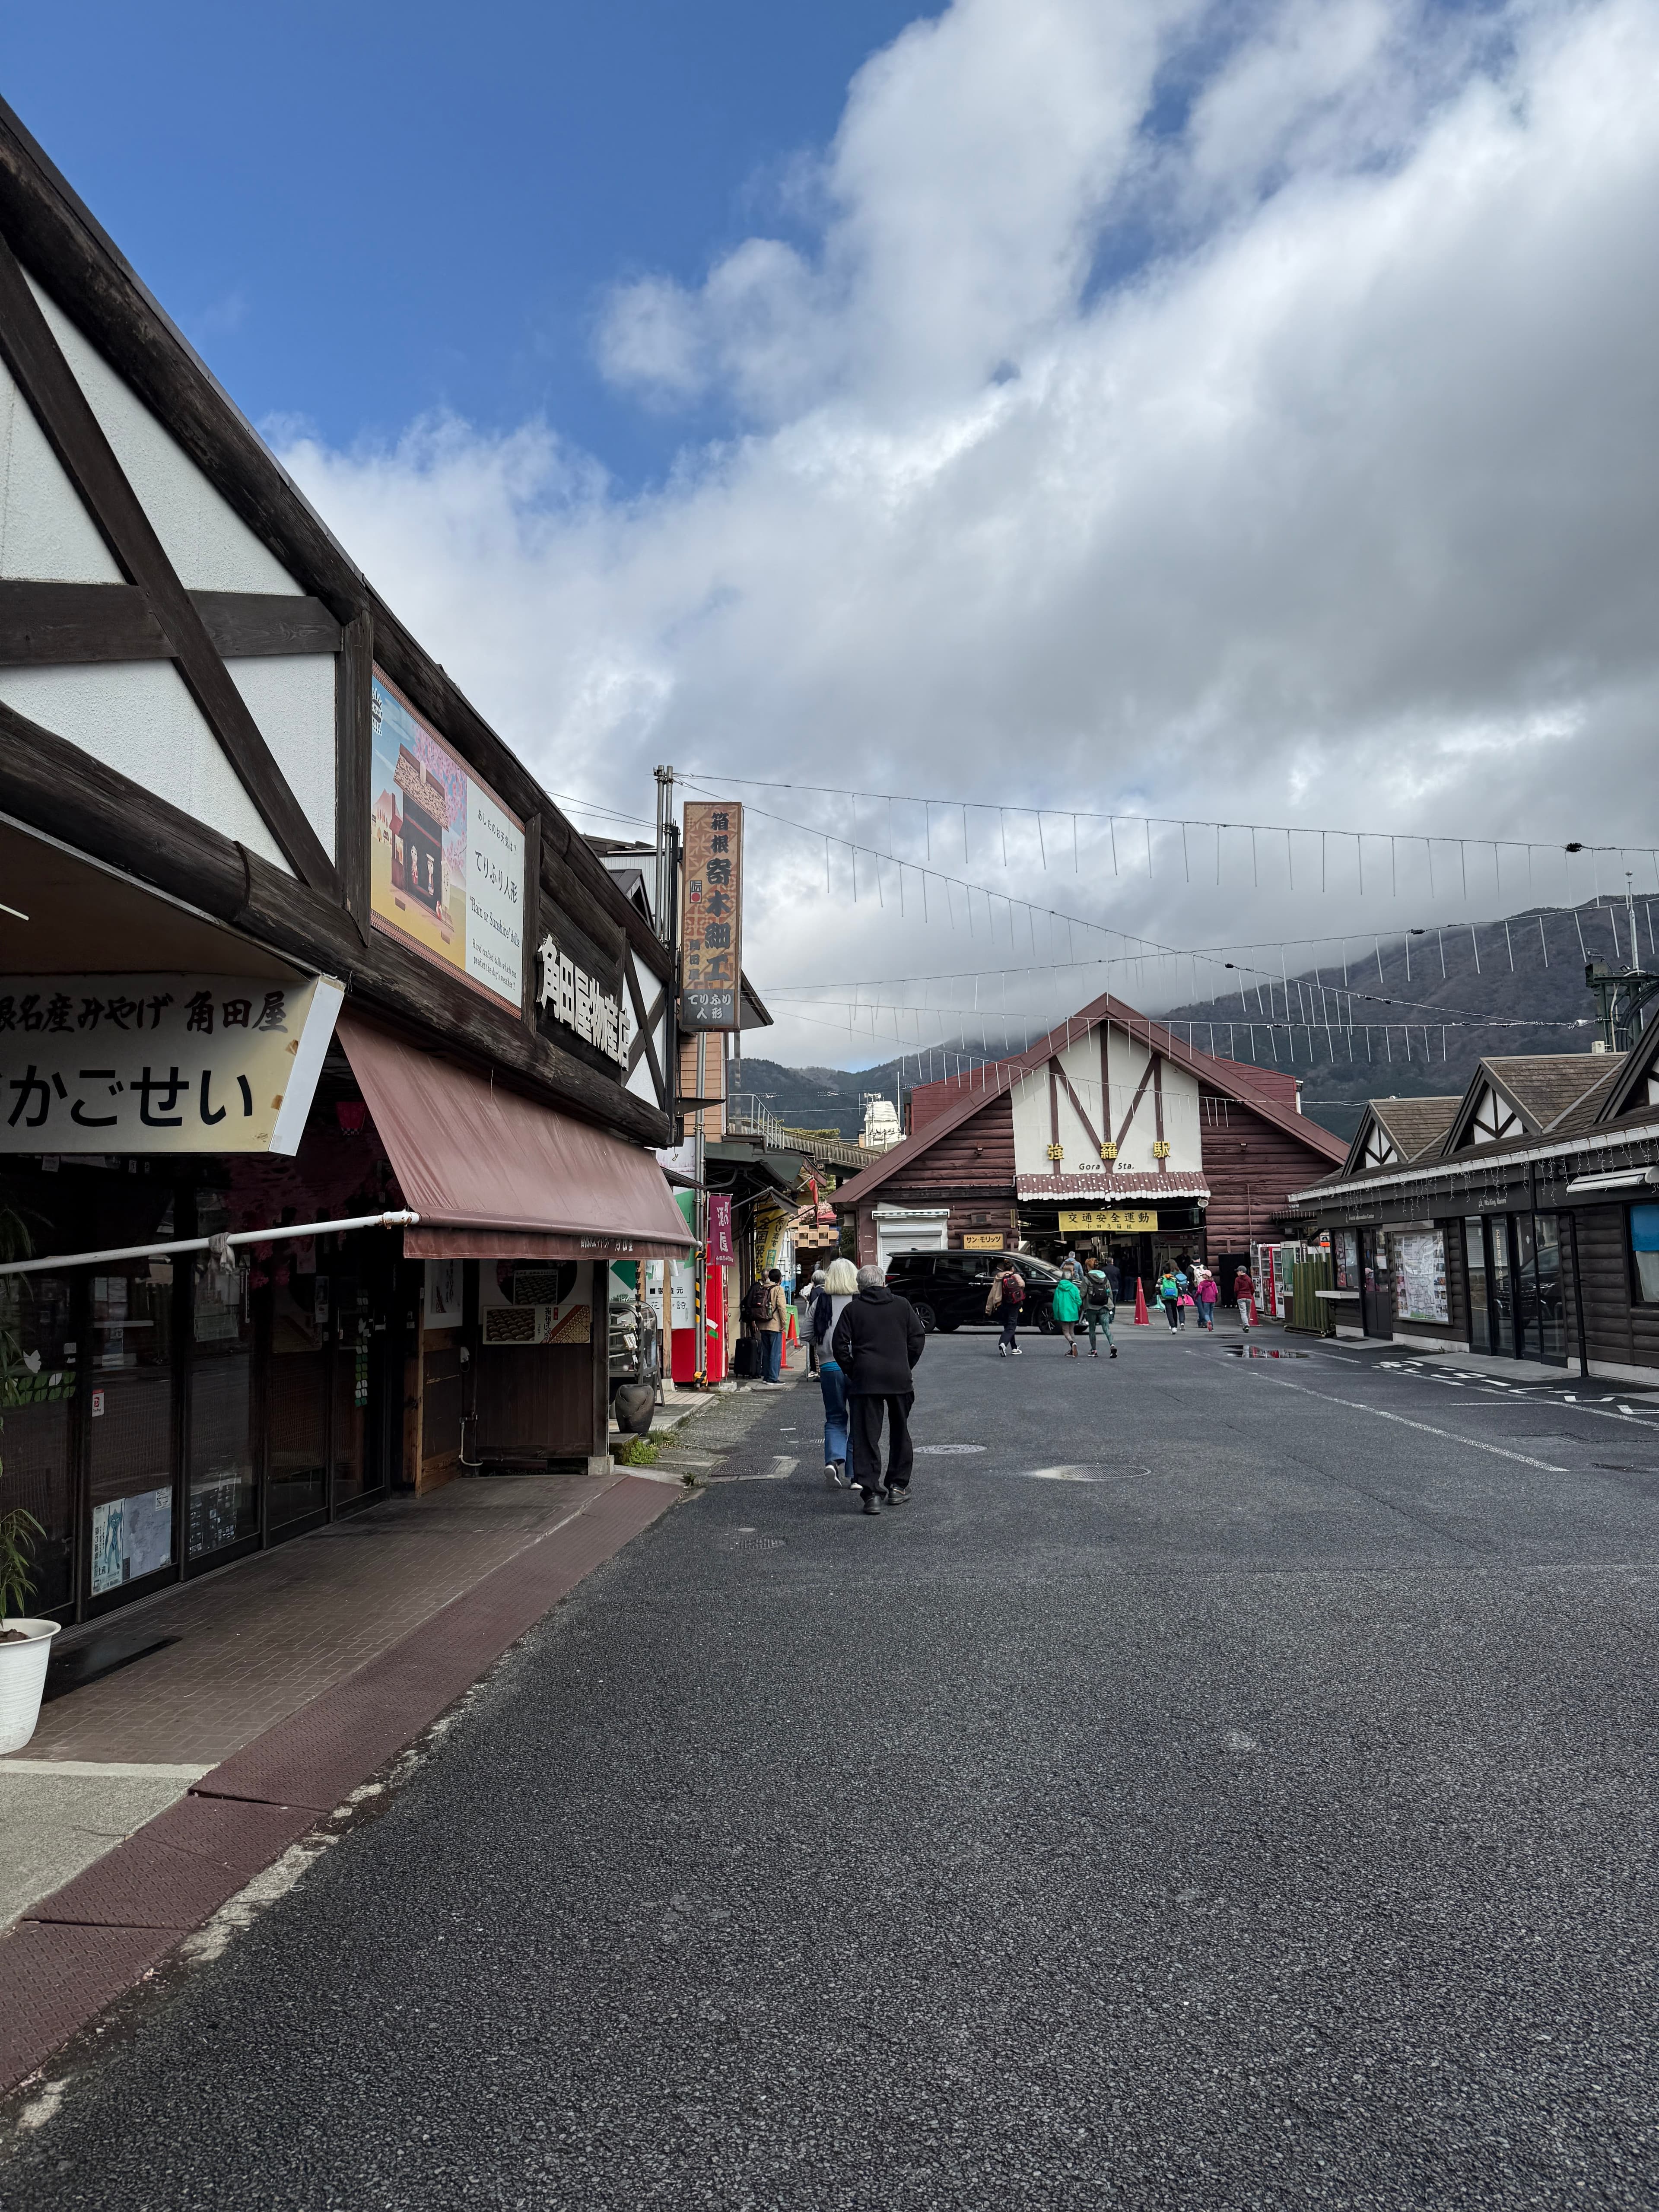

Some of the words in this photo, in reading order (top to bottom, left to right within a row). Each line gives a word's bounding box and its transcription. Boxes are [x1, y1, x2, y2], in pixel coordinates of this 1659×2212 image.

[475, 850, 517, 903] てりふり人形
[705, 812, 731, 981] 箱根寄木細工
[484, 912, 489, 922] or
[511, 930, 520, 947] dolls
[185, 990, 288, 1034] 角田屋
[537, 934, 630, 1071] 角田屋物産店
[688, 994, 731, 1005] てりふり
[696, 1007, 723, 1019] 人形
[0, 1065, 252, 1127] かごせい
[1047, 1141, 1171, 1160] 強羅駅
[1068, 1212, 1149, 1223] 交通安全運動
